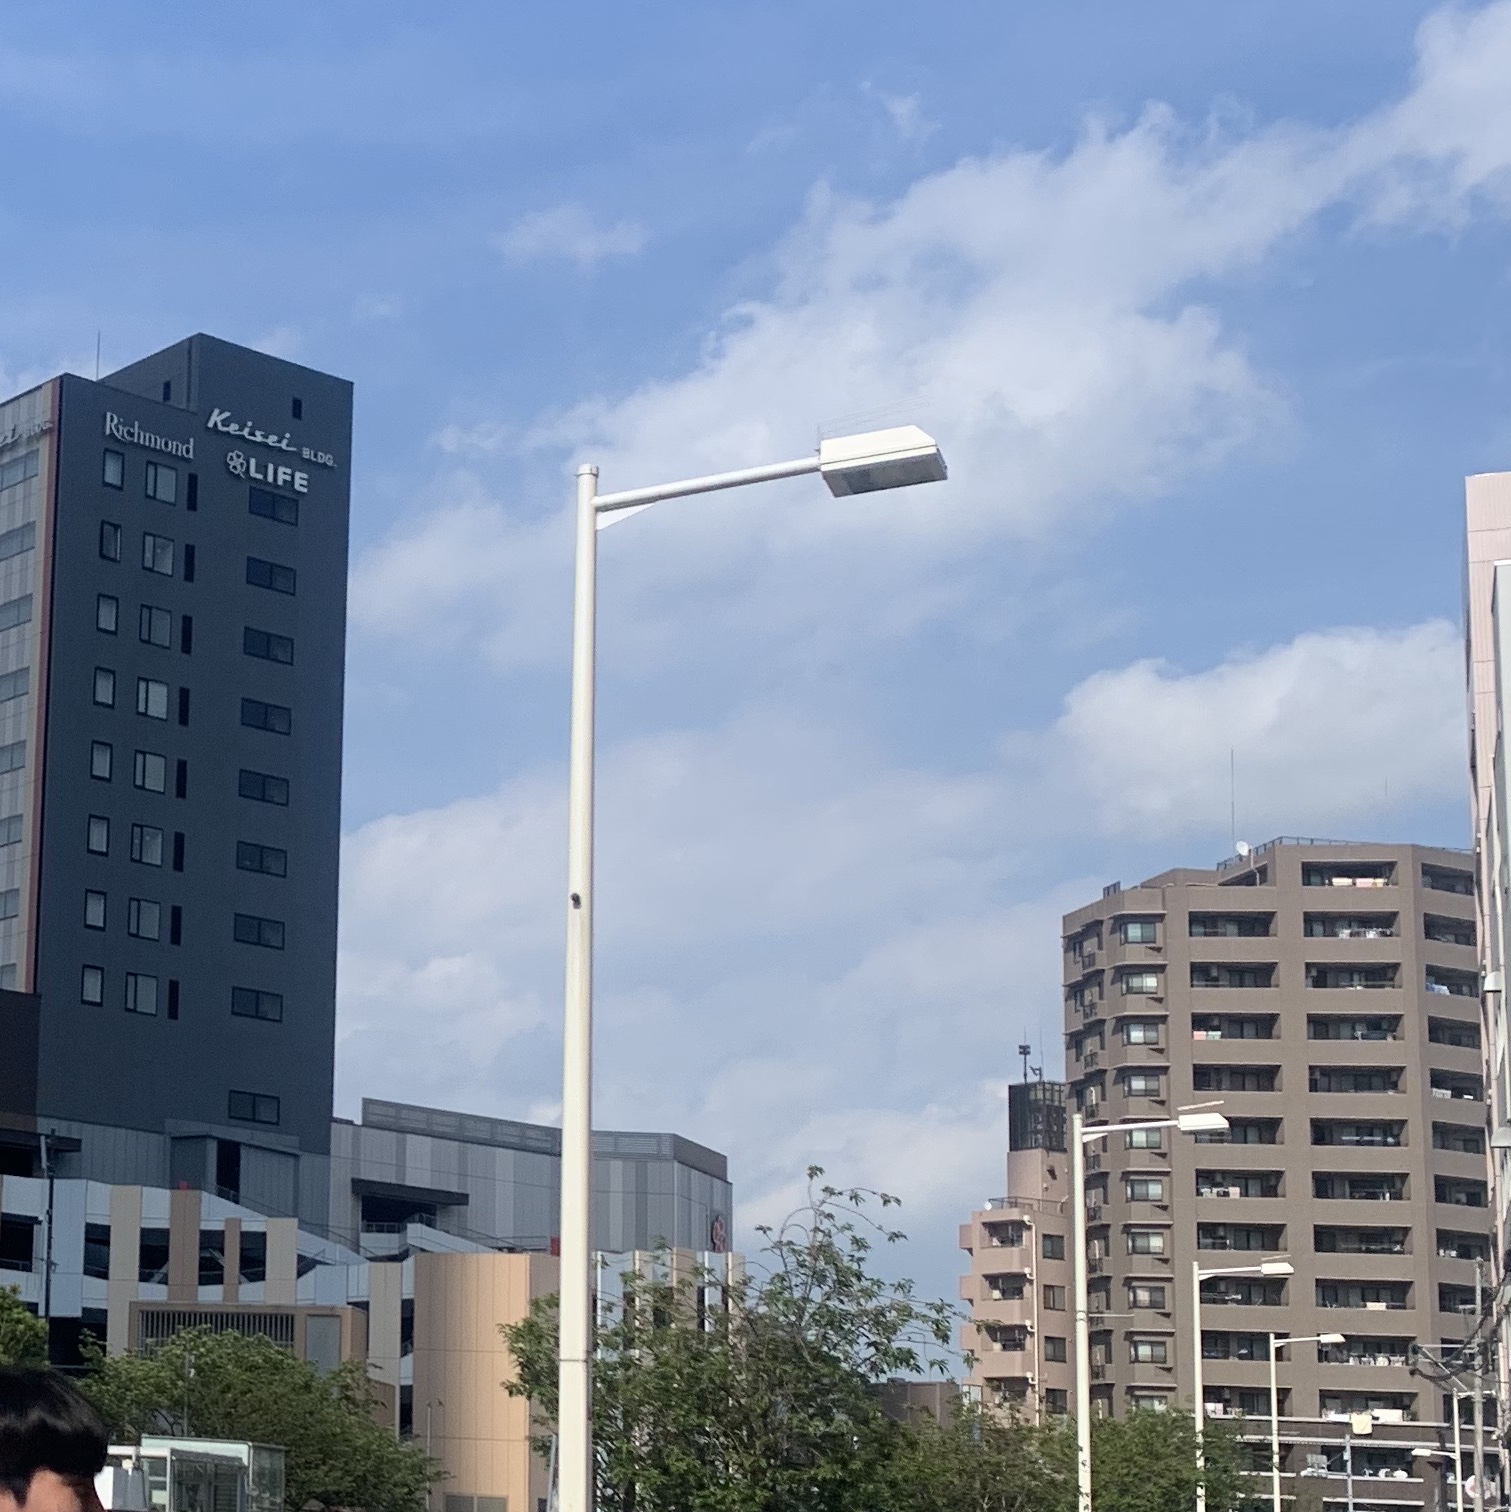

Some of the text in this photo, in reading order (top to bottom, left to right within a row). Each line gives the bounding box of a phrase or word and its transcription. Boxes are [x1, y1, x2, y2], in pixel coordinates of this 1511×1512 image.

[104, 411, 194, 459] Richmond
[207, 408, 297, 451] Keisei
[249, 457, 310, 493] LIFE
